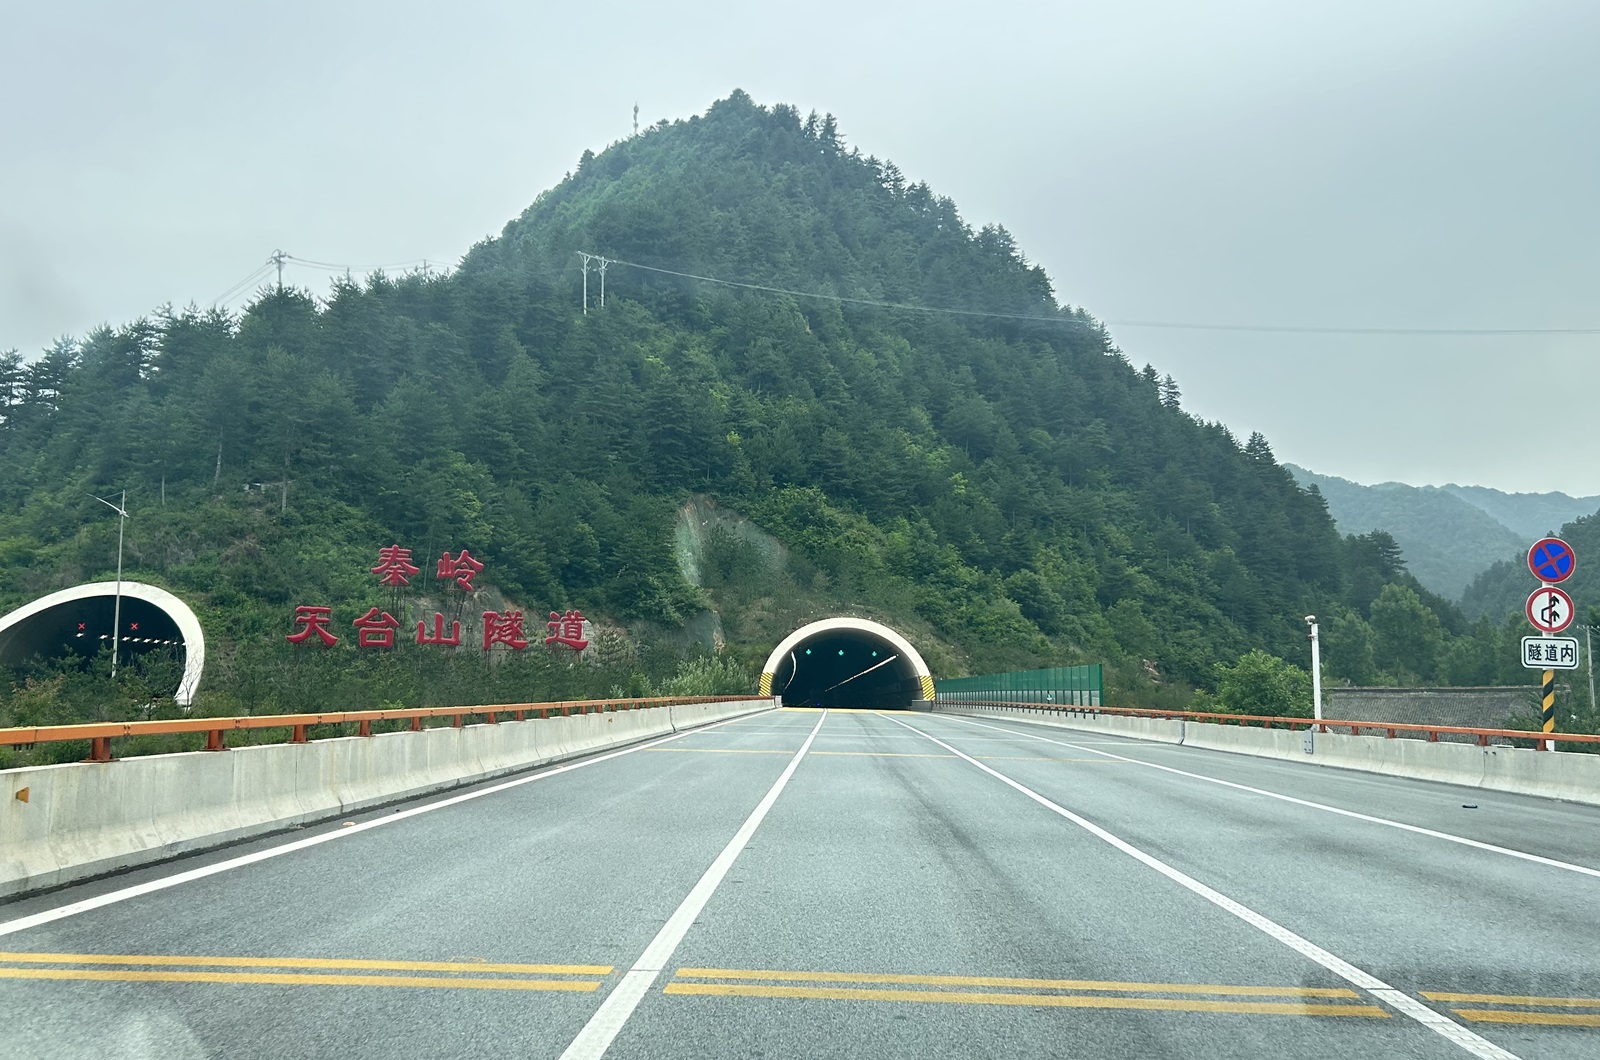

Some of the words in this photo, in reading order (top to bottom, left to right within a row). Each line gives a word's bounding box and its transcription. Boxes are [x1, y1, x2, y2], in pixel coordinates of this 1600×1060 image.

[371, 544, 484, 591] 秦岭
[286, 606, 589, 650] 天台山隧道
[1528, 643, 1574, 662] 隧道内
